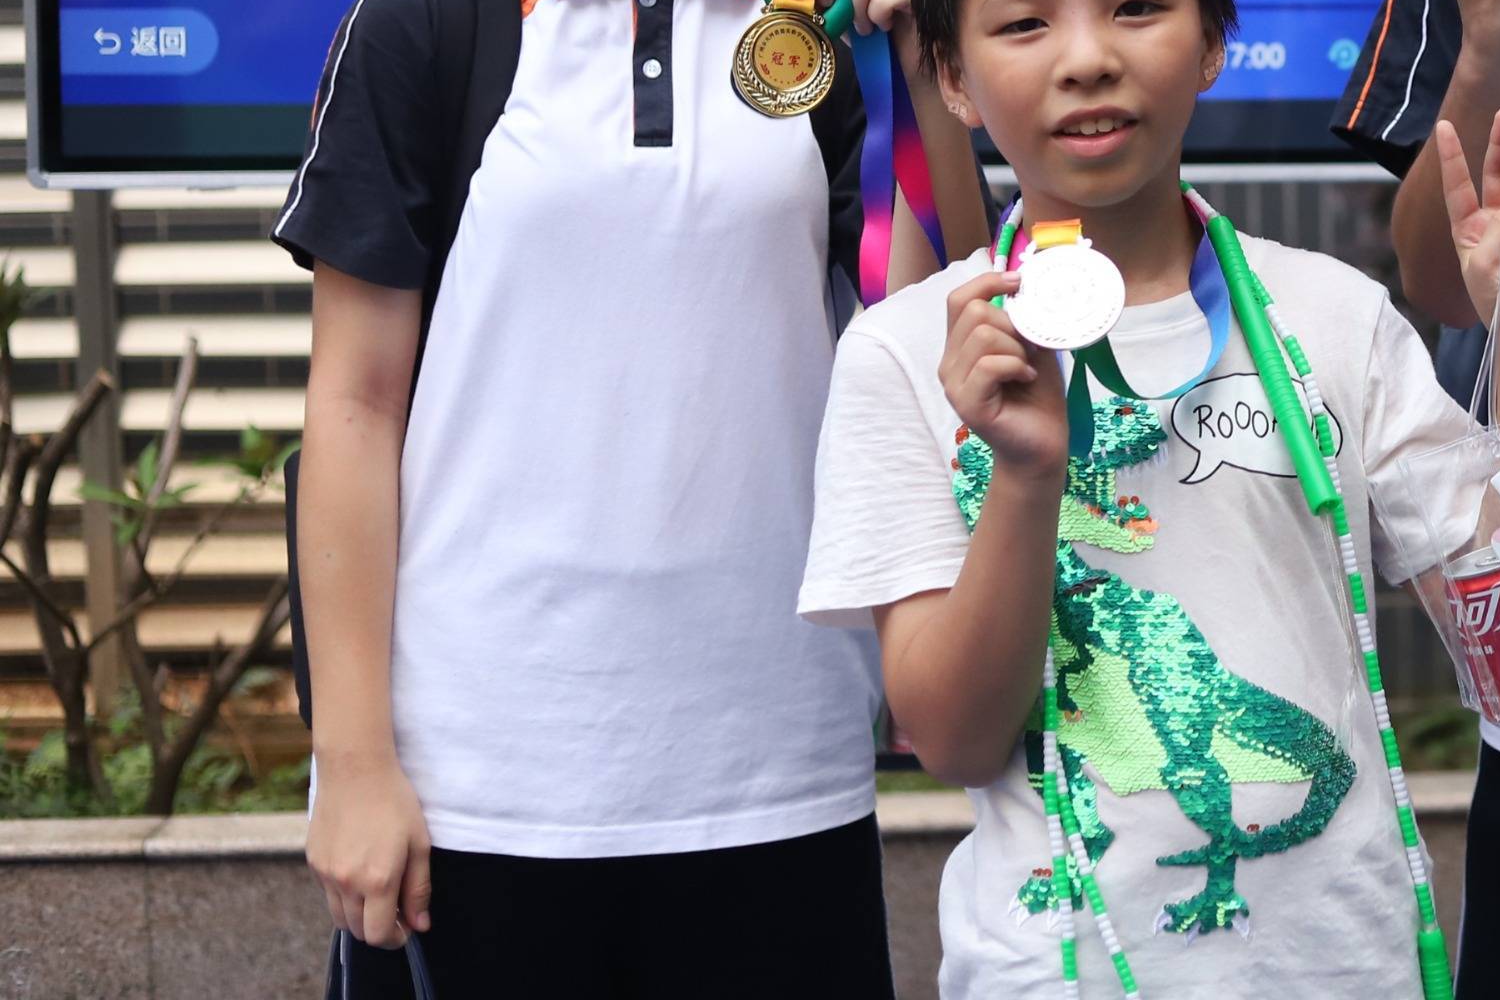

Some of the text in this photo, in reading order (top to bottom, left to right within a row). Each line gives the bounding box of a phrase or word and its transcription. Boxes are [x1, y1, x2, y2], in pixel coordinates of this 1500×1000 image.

[130, 26, 187, 57] 返回
[1227, 41, 1287, 70] 7:00
[771, 50, 802, 69] 冠军
